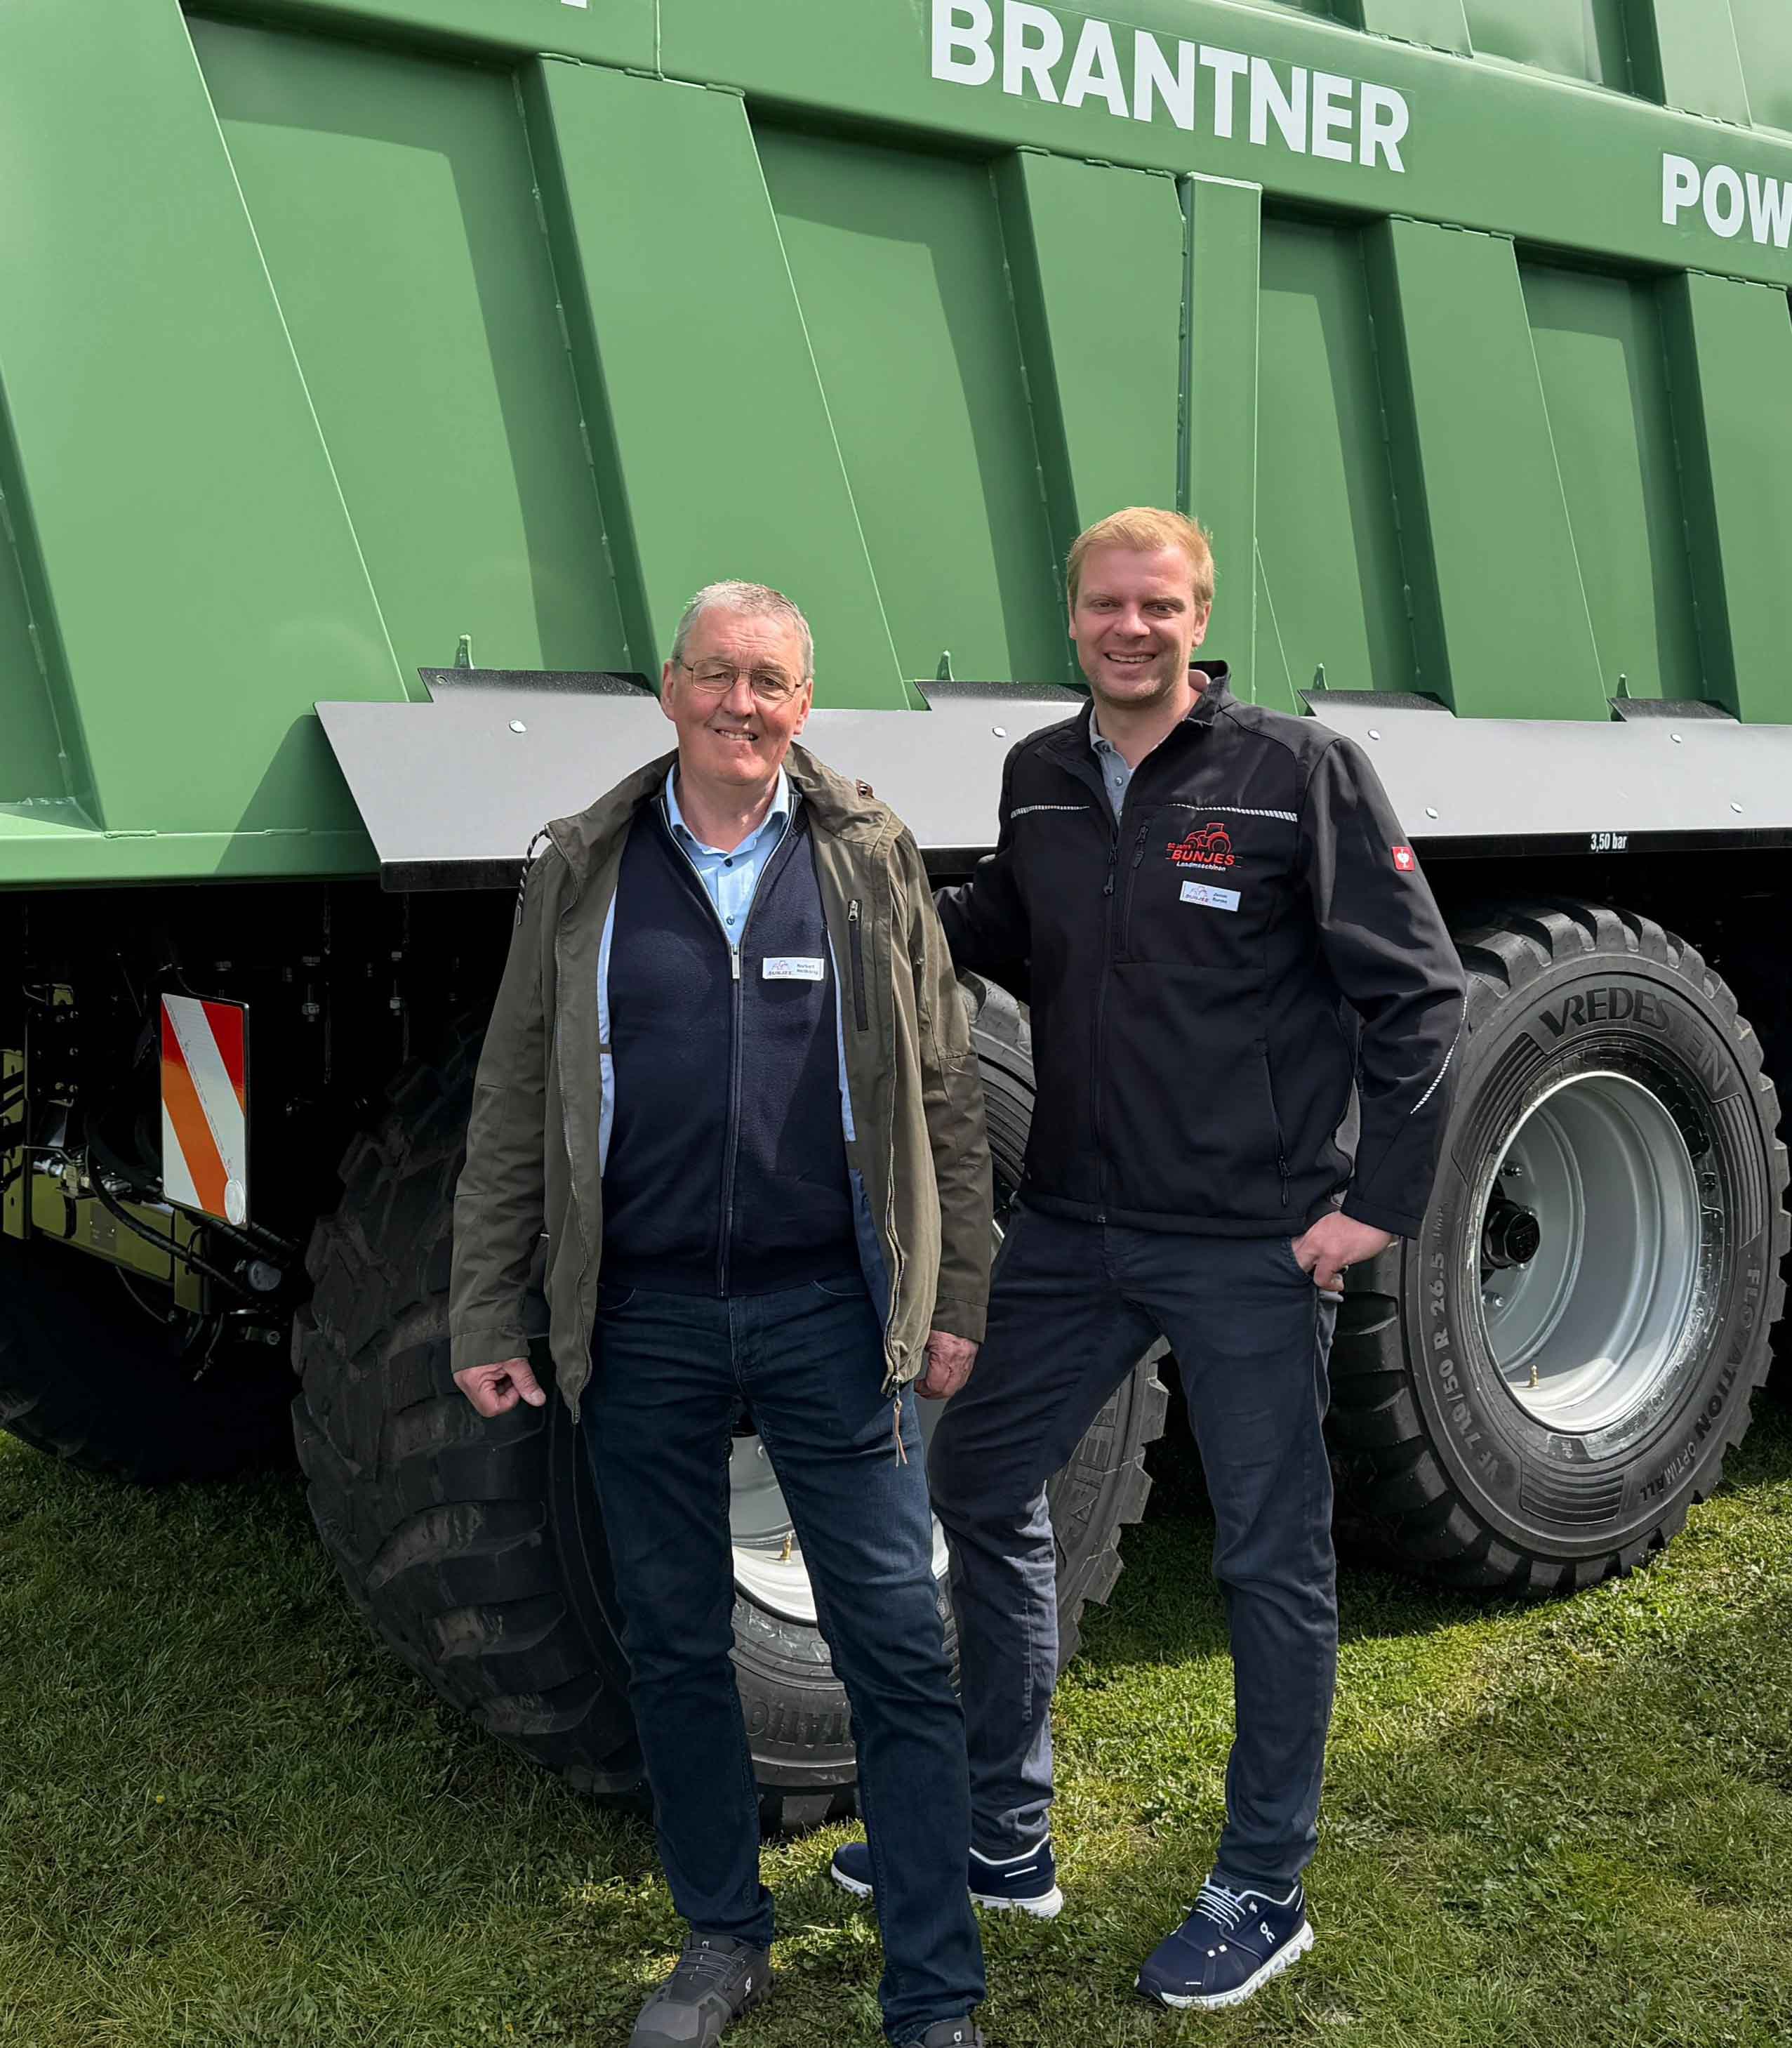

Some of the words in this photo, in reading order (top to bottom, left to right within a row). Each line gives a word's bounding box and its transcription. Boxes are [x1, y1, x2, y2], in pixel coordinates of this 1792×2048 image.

[931, 0, 1409, 173] BRANTNER
[1591, 833, 1610, 853] 3,50
[1612, 832, 1627, 849] bar
[1172, 850, 1235, 866] BUNJES
[1431, 1253, 1445, 1317] 26.5
[1433, 1330, 1449, 1351] R
